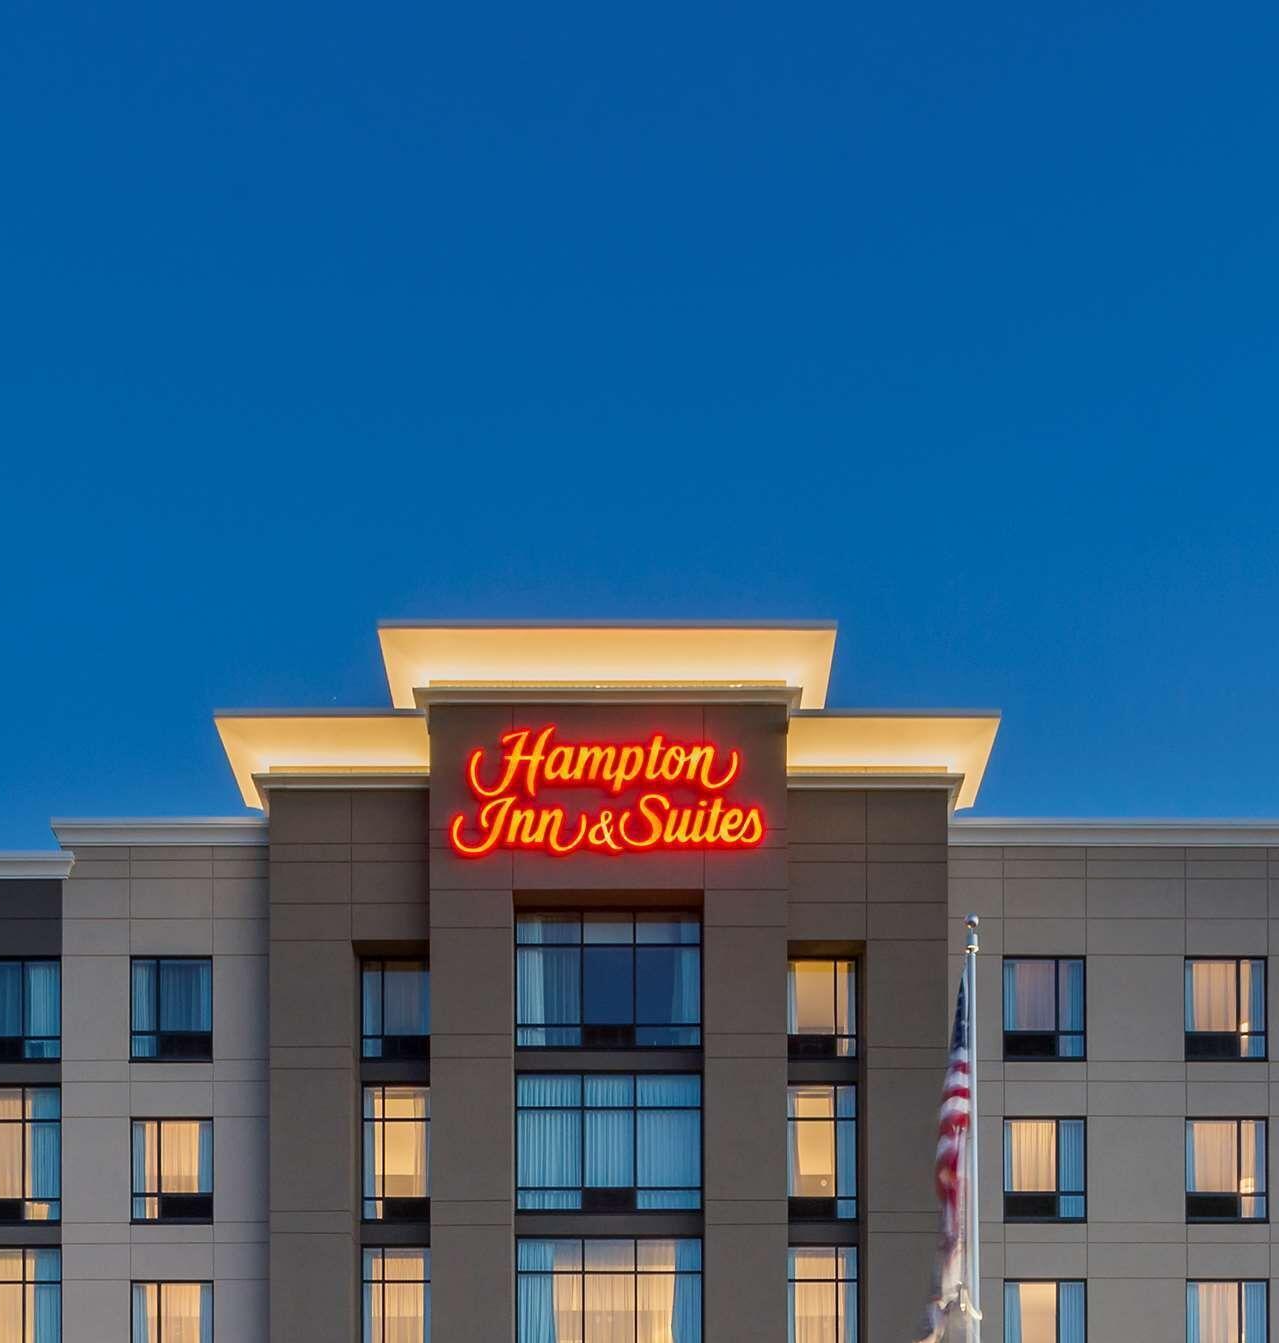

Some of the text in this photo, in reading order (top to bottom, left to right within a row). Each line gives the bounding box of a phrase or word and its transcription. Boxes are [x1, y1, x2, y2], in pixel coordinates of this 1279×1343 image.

[470, 726, 738, 797] Hampton
[452, 793, 763, 854] Inn & Suites
